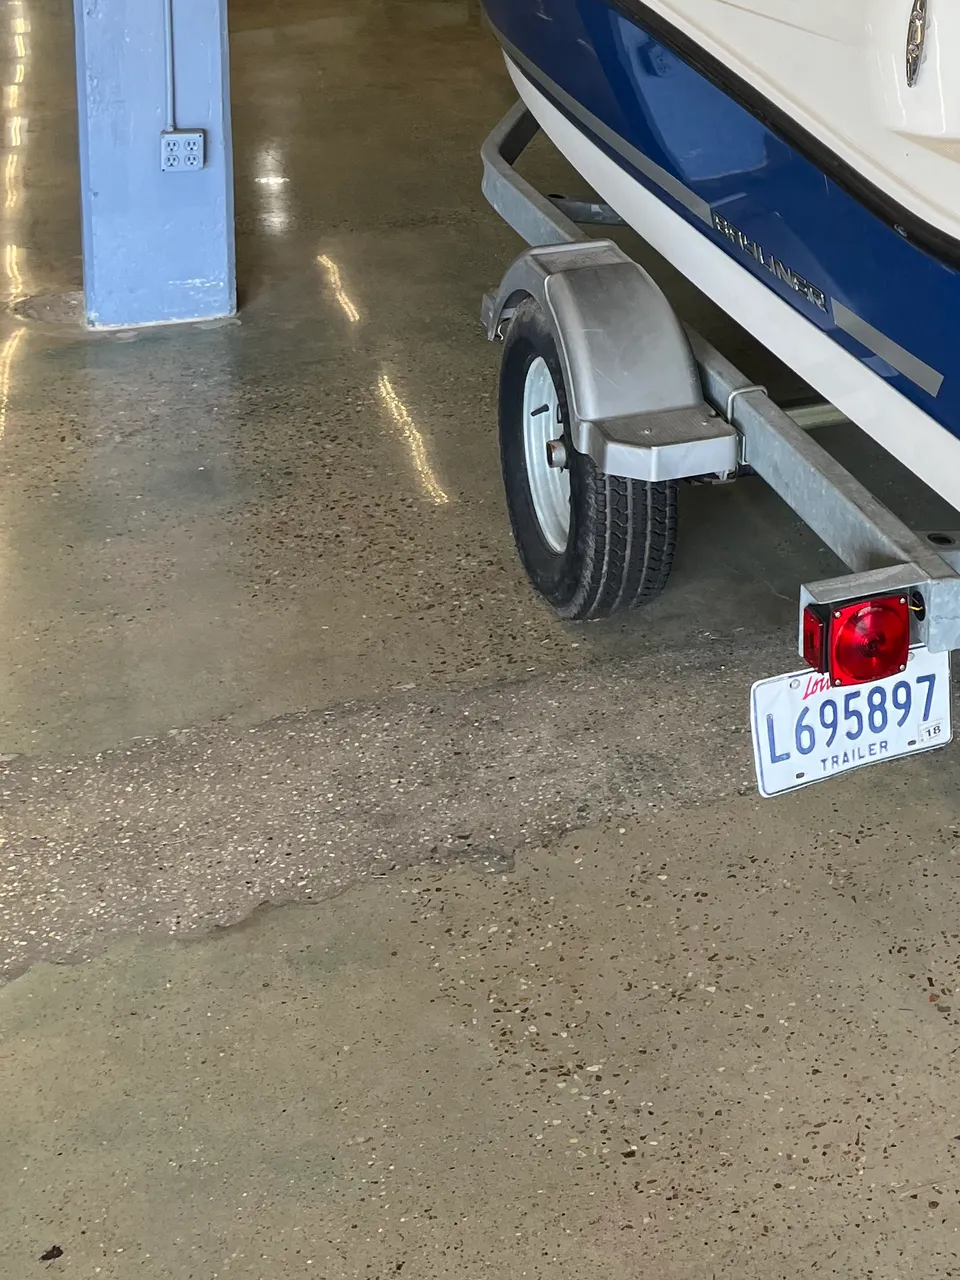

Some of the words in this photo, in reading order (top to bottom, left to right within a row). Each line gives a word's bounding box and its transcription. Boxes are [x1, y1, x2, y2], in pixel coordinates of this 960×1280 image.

[713, 211, 828, 314] BAYLINER
[766, 673, 937, 764] L695897
[924, 725, 941, 737] 18
[820, 740, 889, 772] TRAILER
